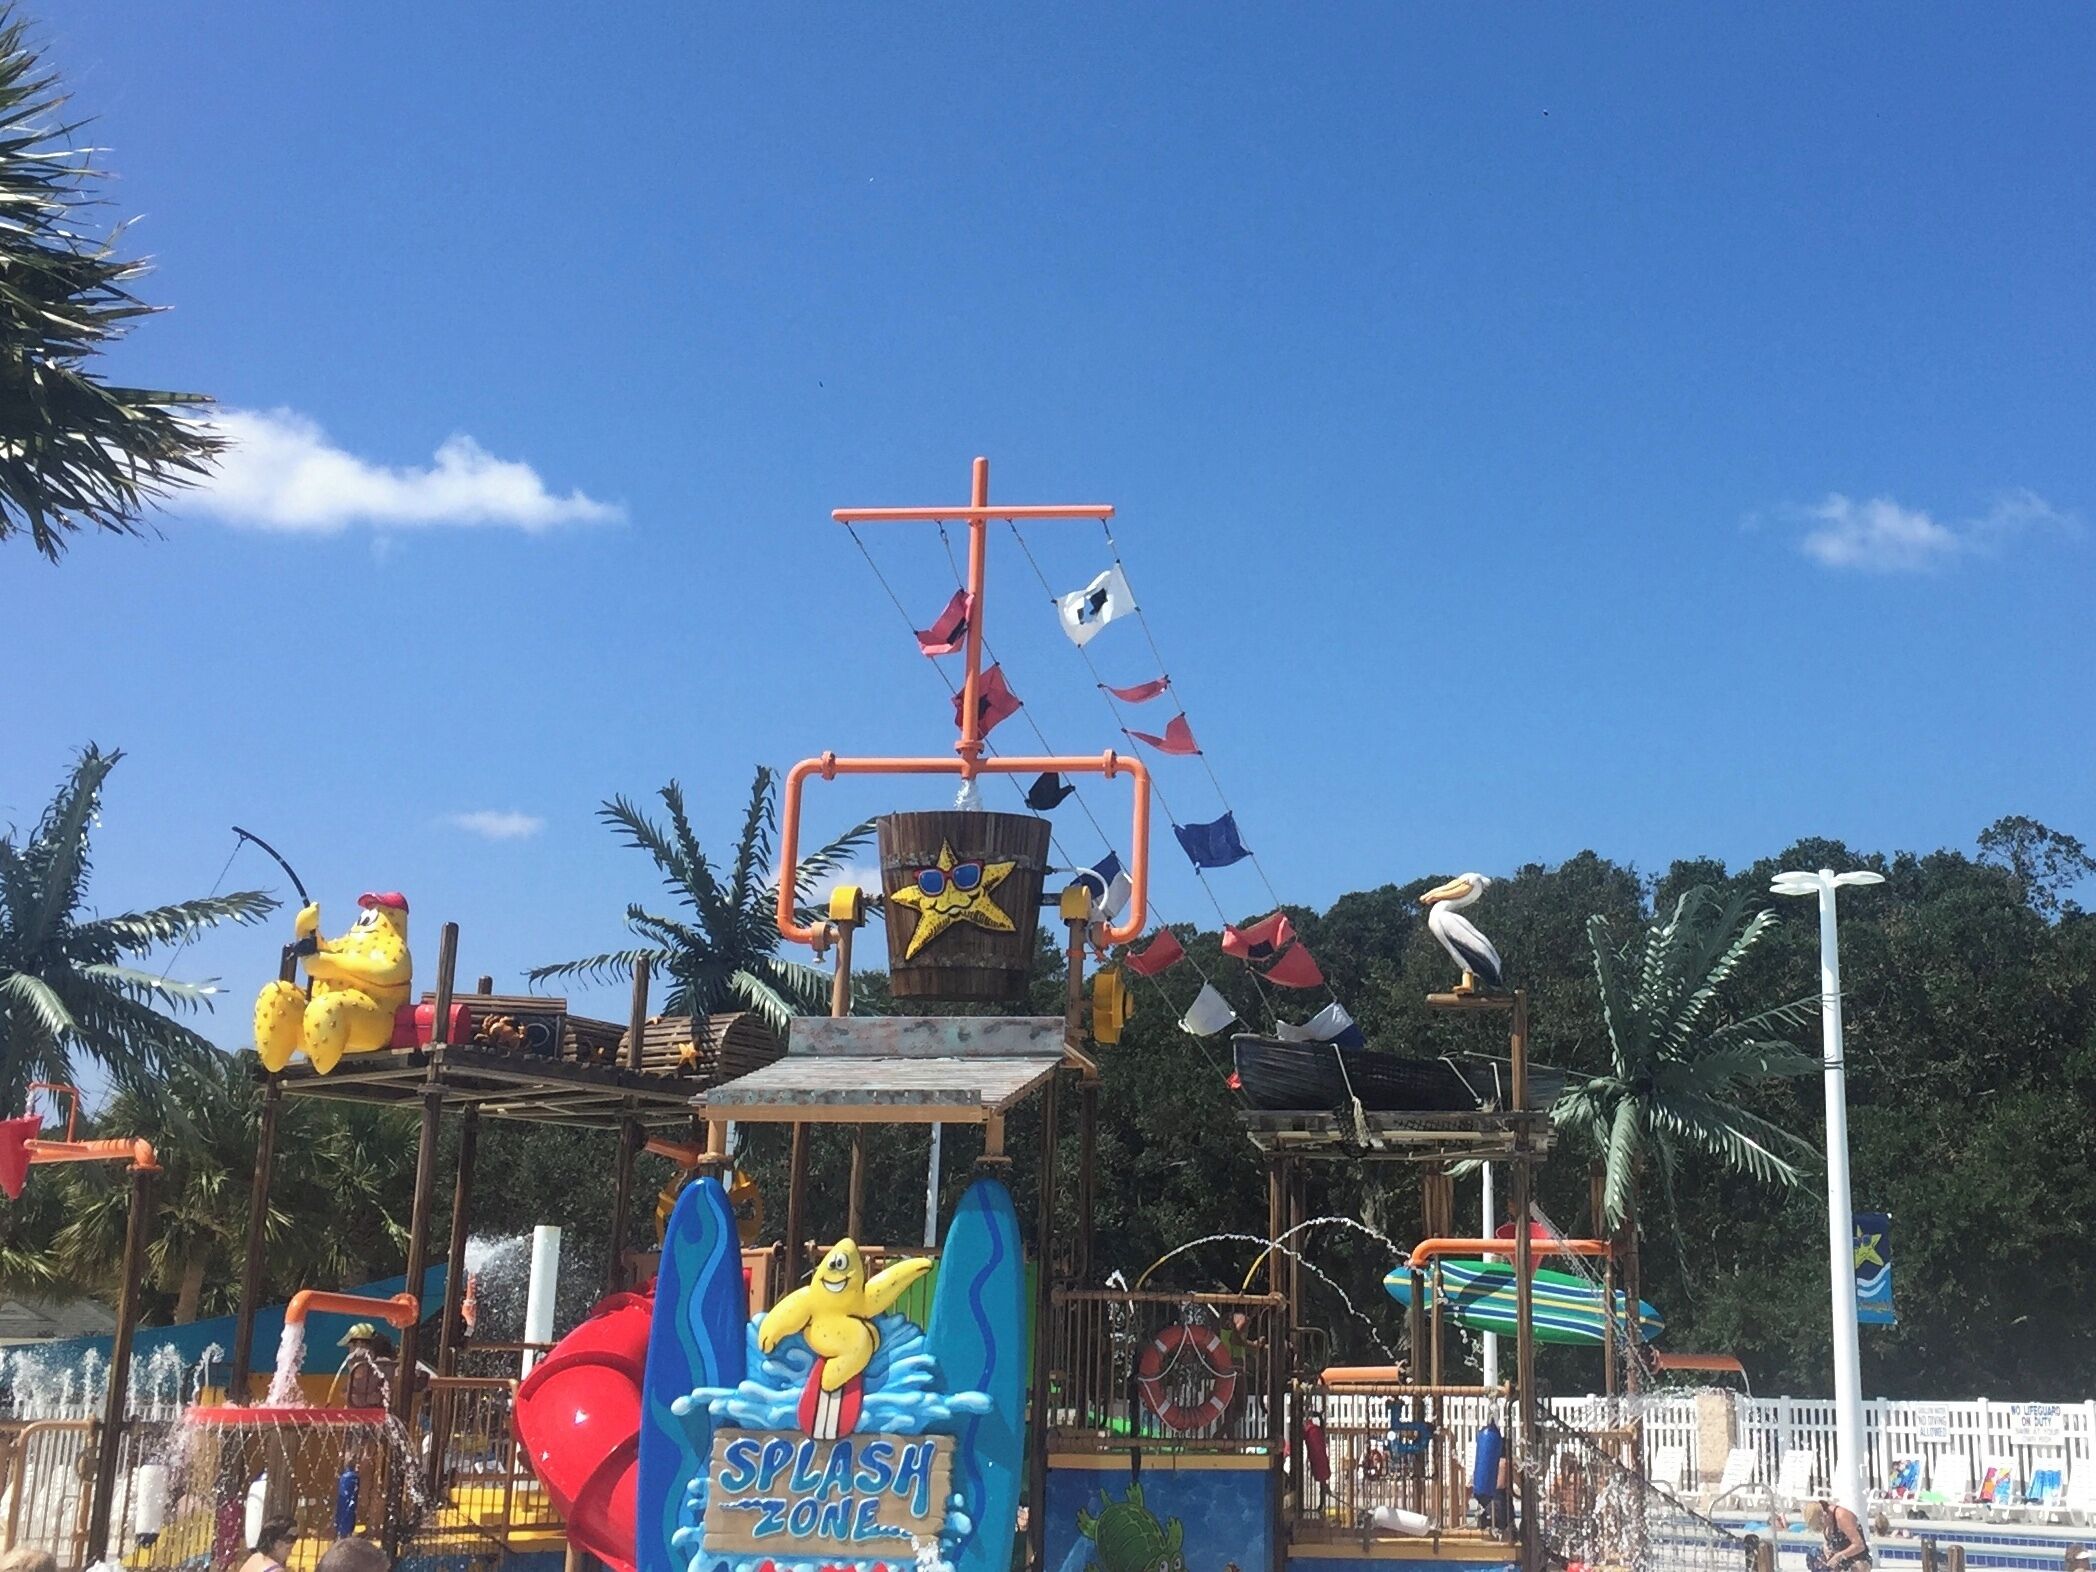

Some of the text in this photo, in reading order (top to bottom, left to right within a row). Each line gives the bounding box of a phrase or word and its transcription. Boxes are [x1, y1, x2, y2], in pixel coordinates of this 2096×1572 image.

[2011, 1404, 2061, 1417] NO LIFEGUARD
[2021, 1416, 2052, 1427] ON DUTY
[1920, 1426, 1947, 1437] ALLOWED
[718, 1437, 936, 1519] SPLASH
[719, 1497, 912, 1542] ZONE
